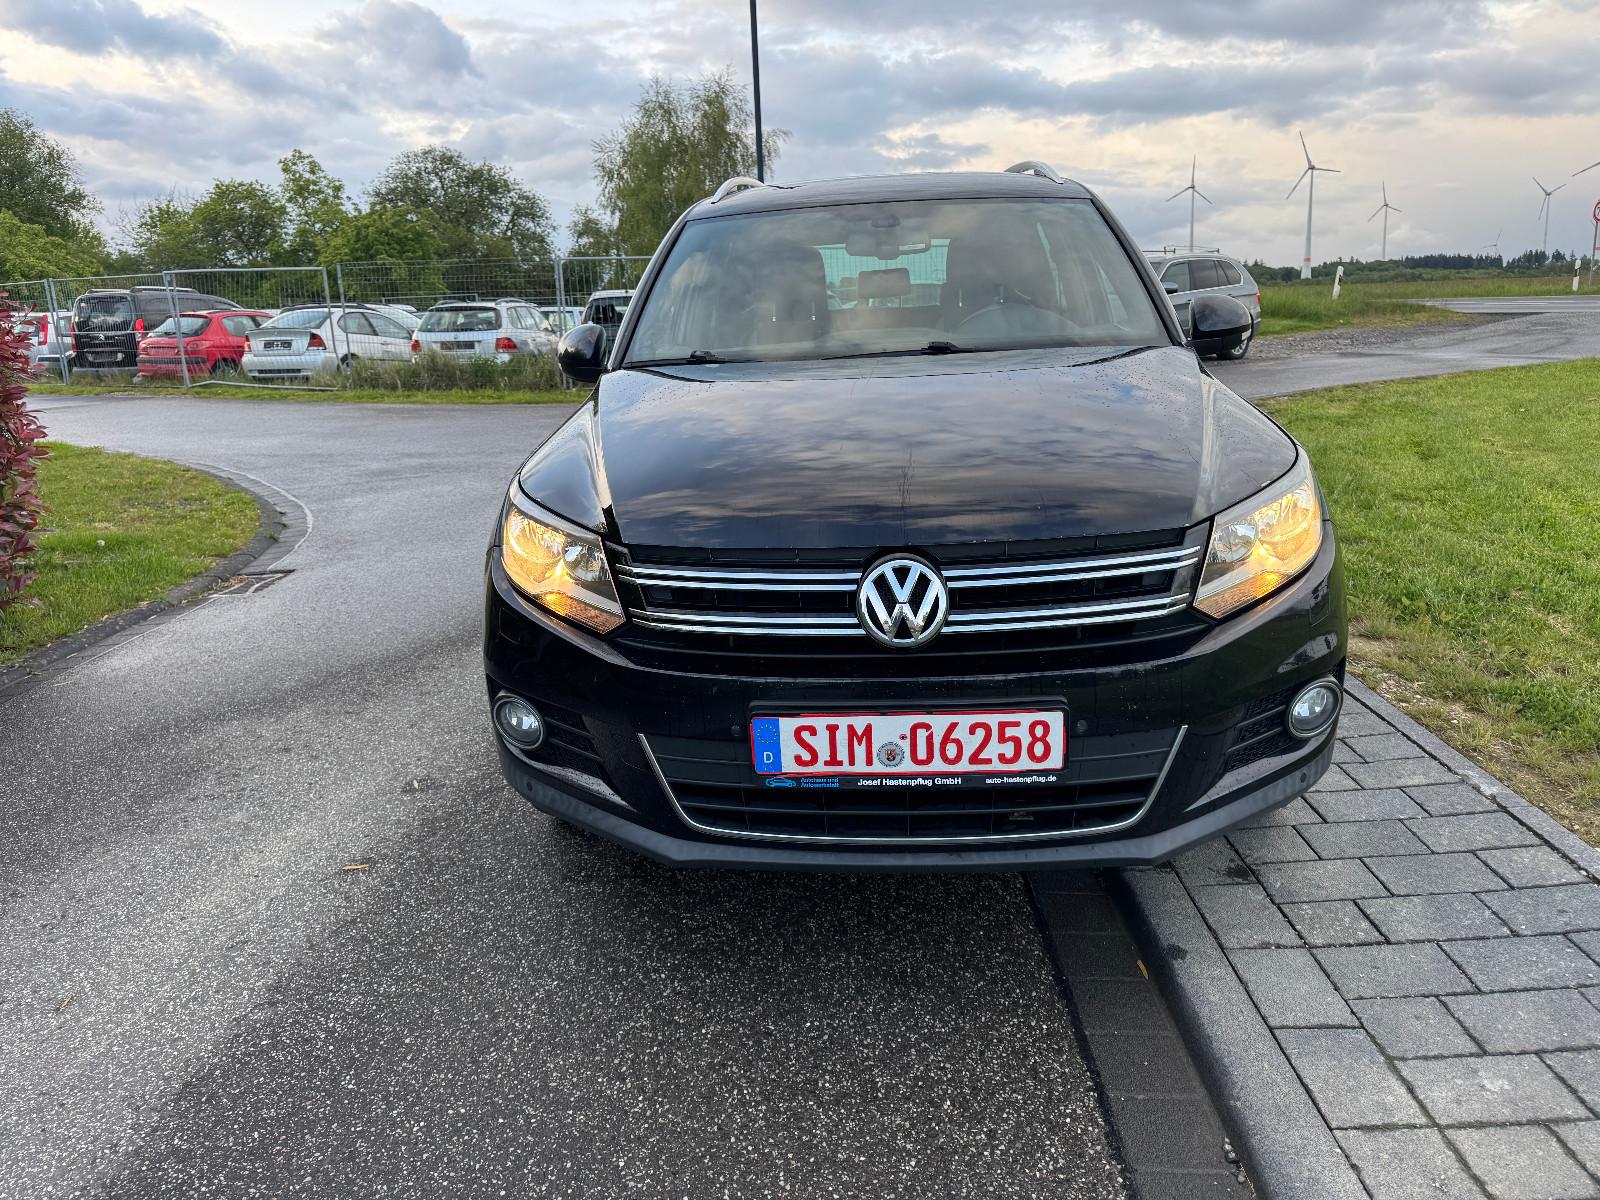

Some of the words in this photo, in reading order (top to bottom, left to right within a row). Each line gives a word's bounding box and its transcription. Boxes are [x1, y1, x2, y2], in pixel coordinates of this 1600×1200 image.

[860, 557, 948, 645] VW
[793, 722, 874, 767] SIM
[909, 719, 1052, 766] 06258
[763, 751, 774, 763] D
[857, 778, 881, 787] Josef
[882, 777, 933, 788] Hastenpflug
[934, 777, 962, 786] GmbH
[985, 775, 1057, 784] auto-hastenpflug.de
